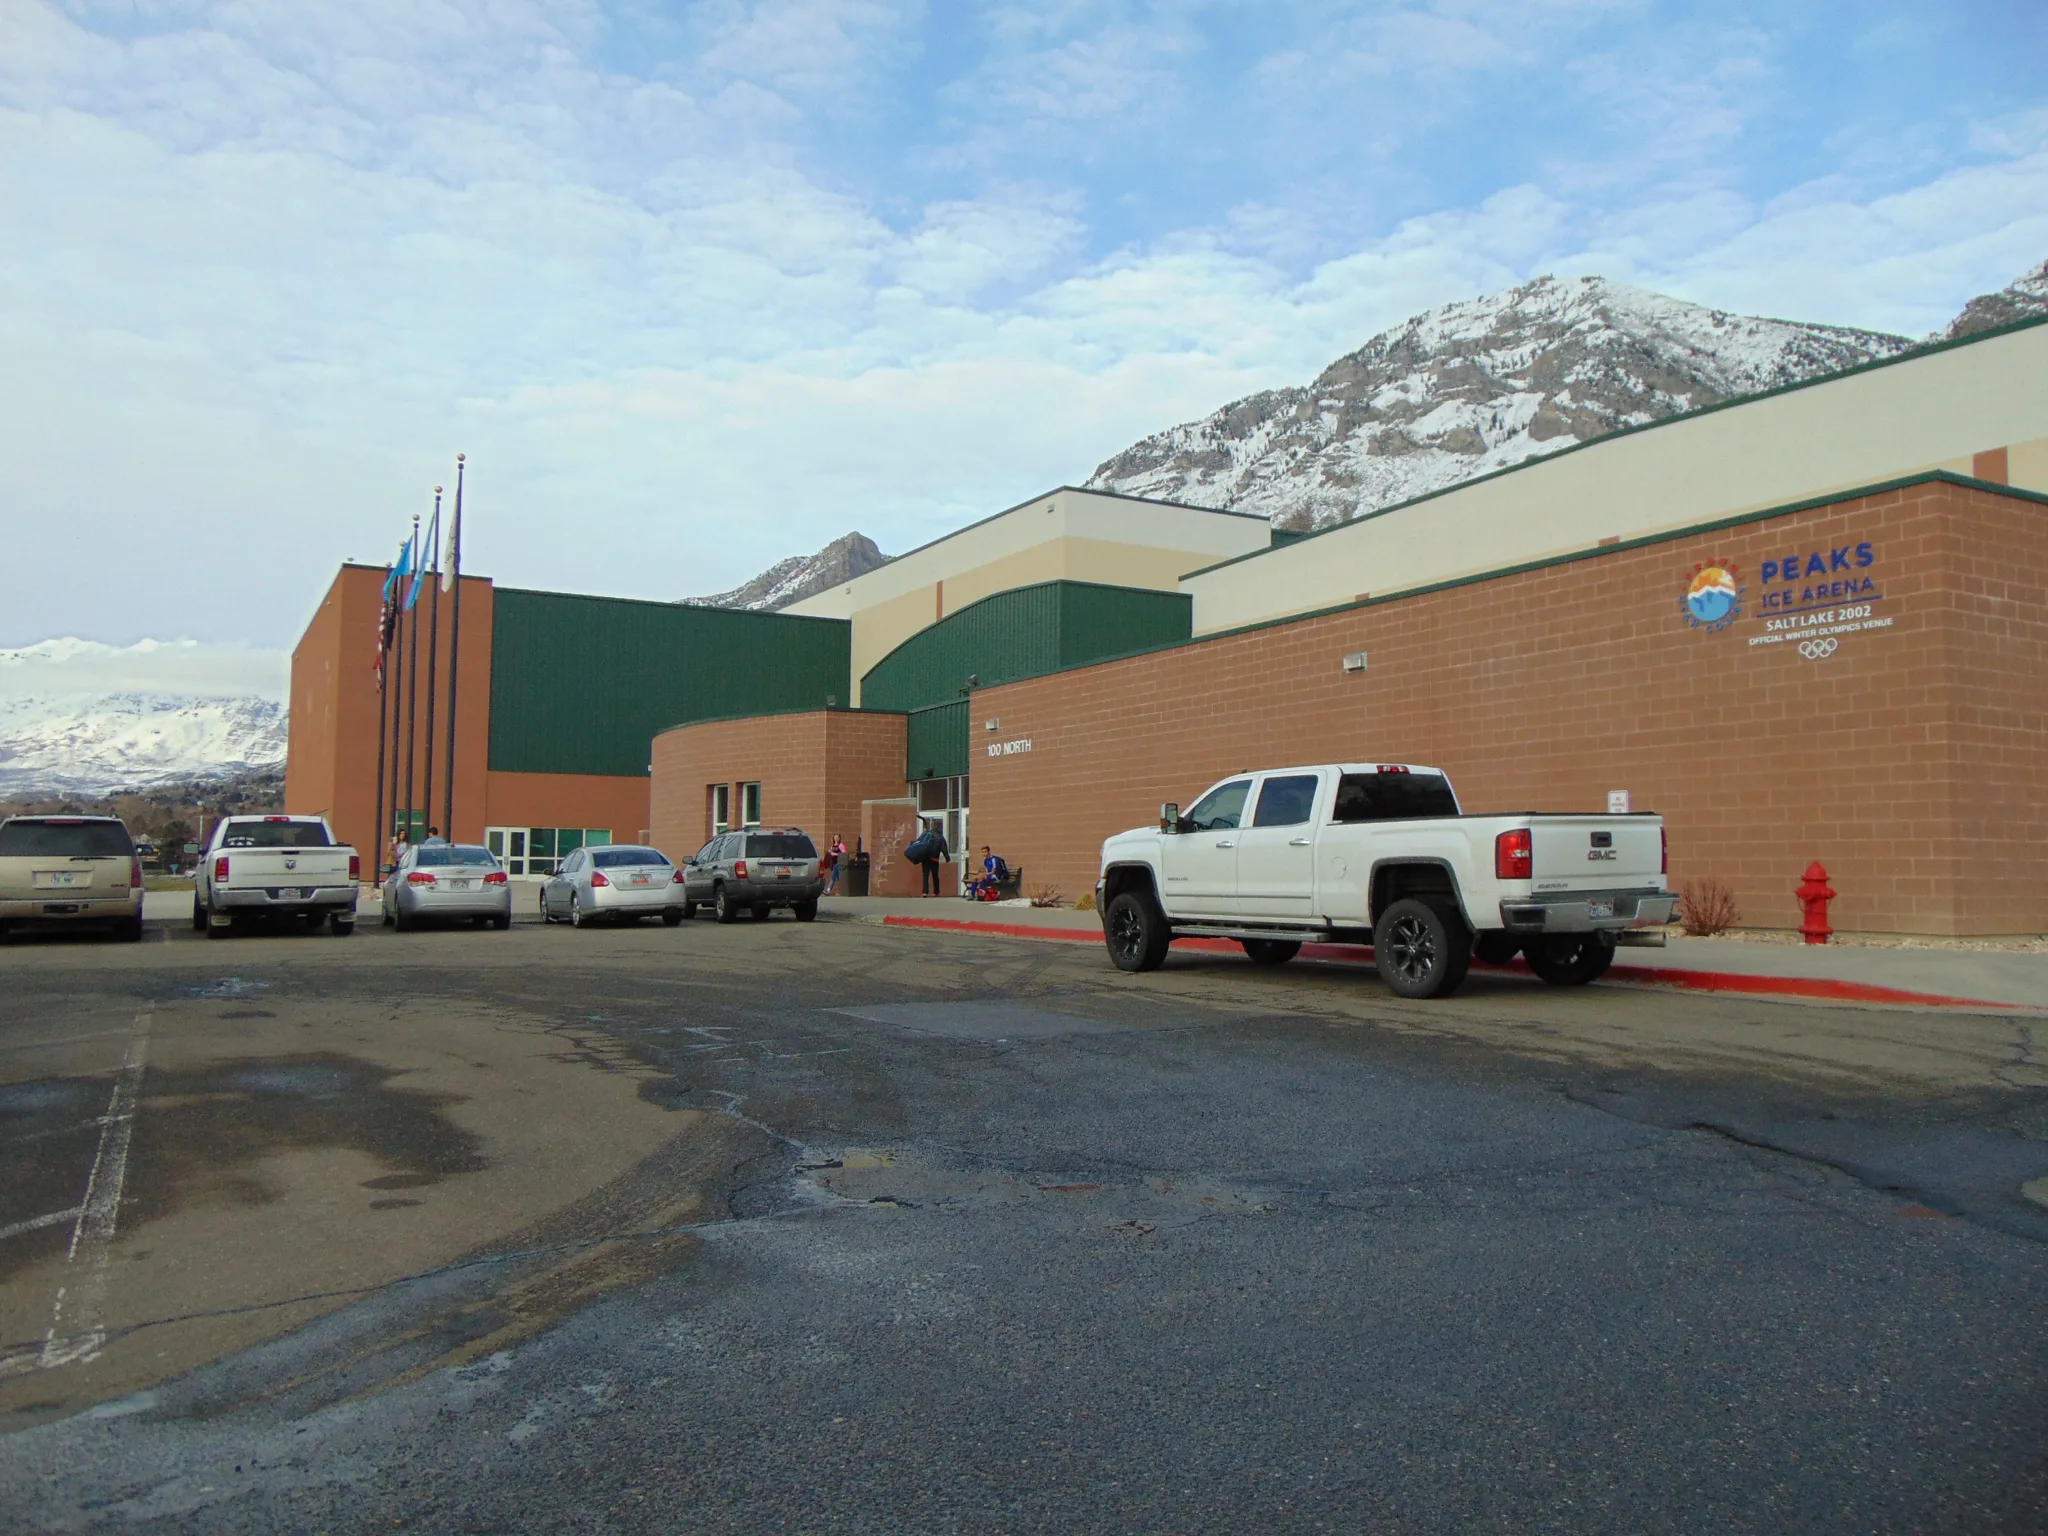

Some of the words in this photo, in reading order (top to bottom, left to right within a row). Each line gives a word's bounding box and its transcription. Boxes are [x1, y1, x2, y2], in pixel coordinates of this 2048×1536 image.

[1761, 542, 1875, 584] PEAKS
[1762, 589, 1793, 608] ICE
[1801, 576, 1875, 602] ARENA
[1749, 634, 1783, 646] OFFICIAL
[1785, 629, 1817, 640] WINTER
[1818, 623, 1861, 635] OLYMPICS
[1863, 617, 1893, 629] VENUE
[1766, 617, 1797, 631] SALT
[1800, 611, 1835, 627] LAKE
[1838, 605, 1872, 621] 2002
[987, 743, 1001, 757] 100
[1003, 739, 1032, 755] NORTH
[1587, 850, 1617, 861] GMC
